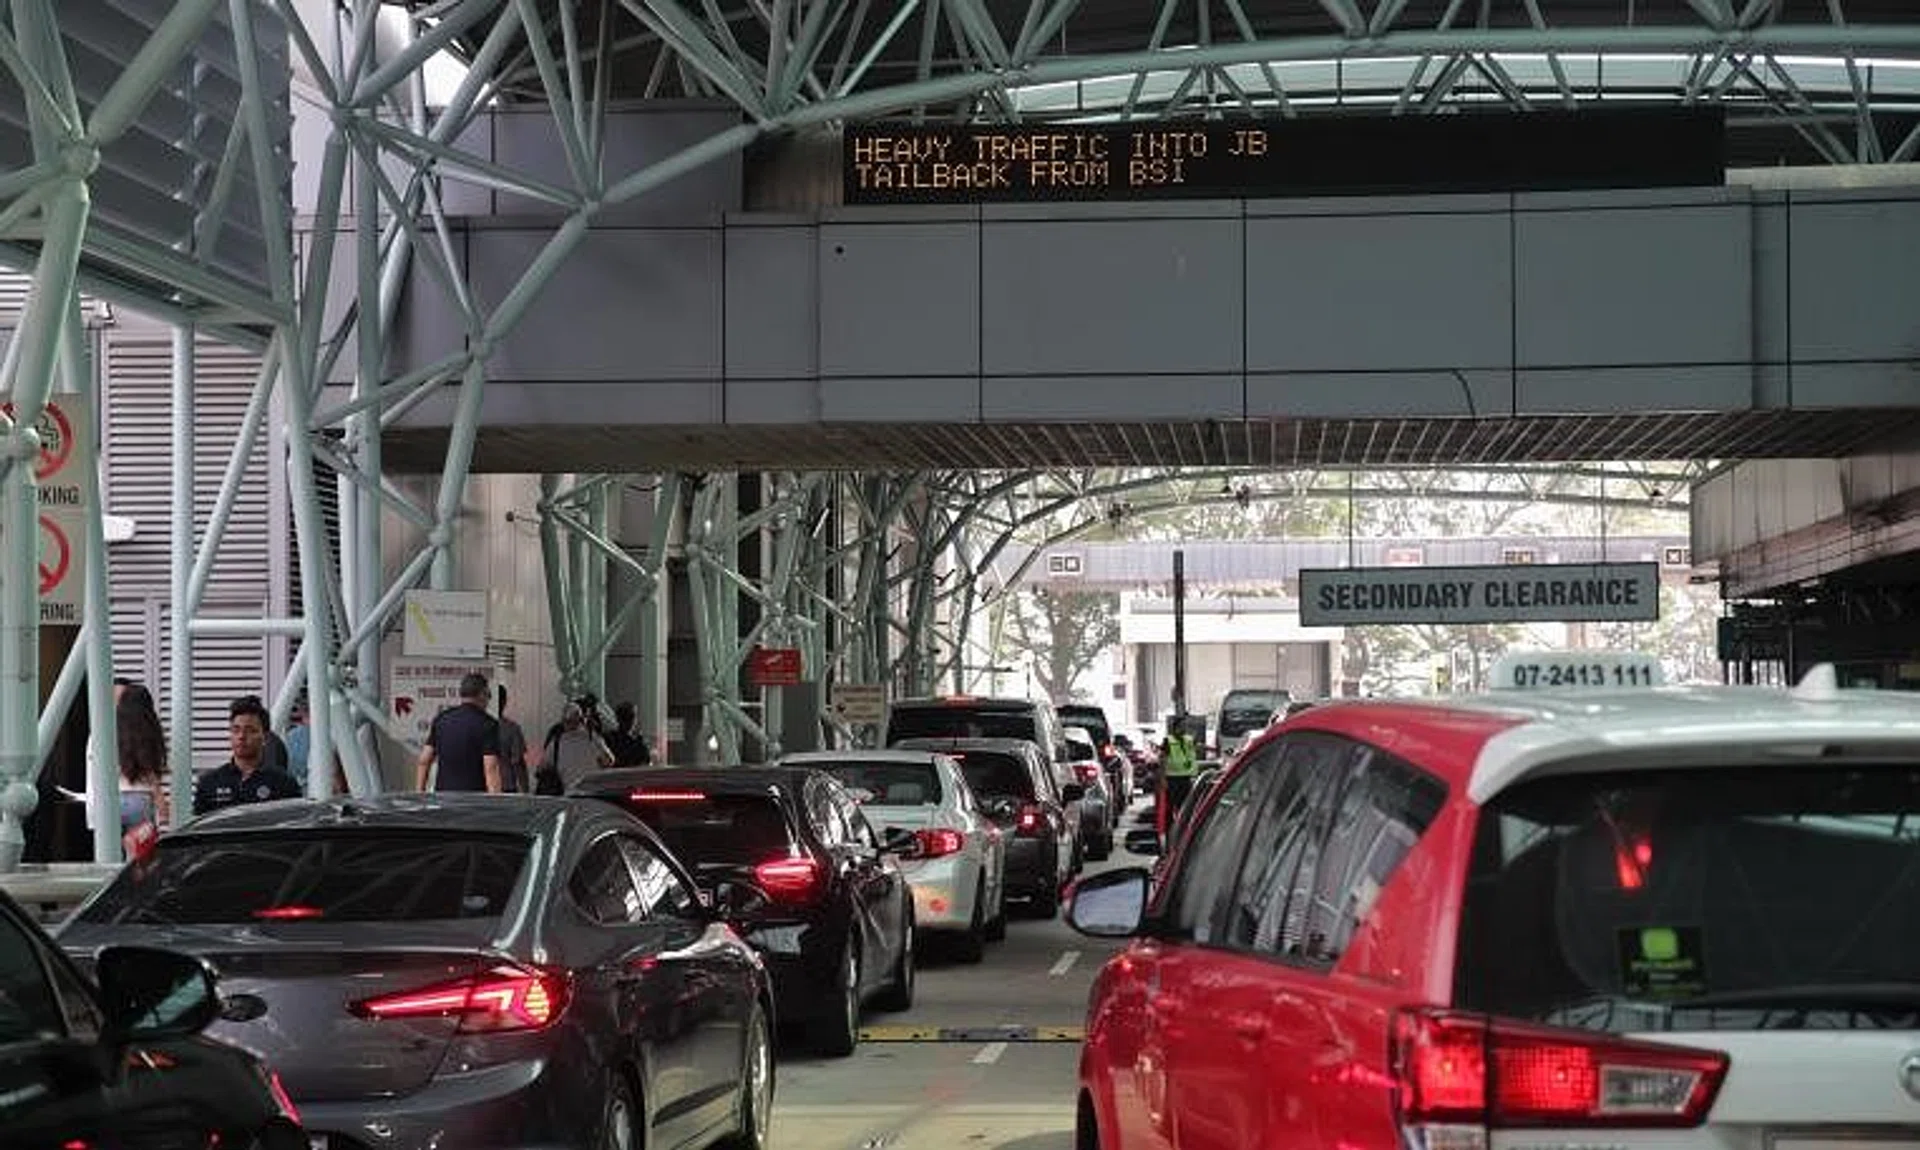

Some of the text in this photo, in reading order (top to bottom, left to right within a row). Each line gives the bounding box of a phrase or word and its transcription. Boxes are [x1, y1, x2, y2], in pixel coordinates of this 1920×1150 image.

[854, 130, 1268, 163] HEAVY TRAFFIC INTO JB
[855, 158, 1185, 189] TAILBACK FROM BSI
[38, 485, 80, 505] KING
[1317, 578, 1639, 611] SECONDARY CLEARANCE
[1514, 664, 1651, 687] 07-2413 111
